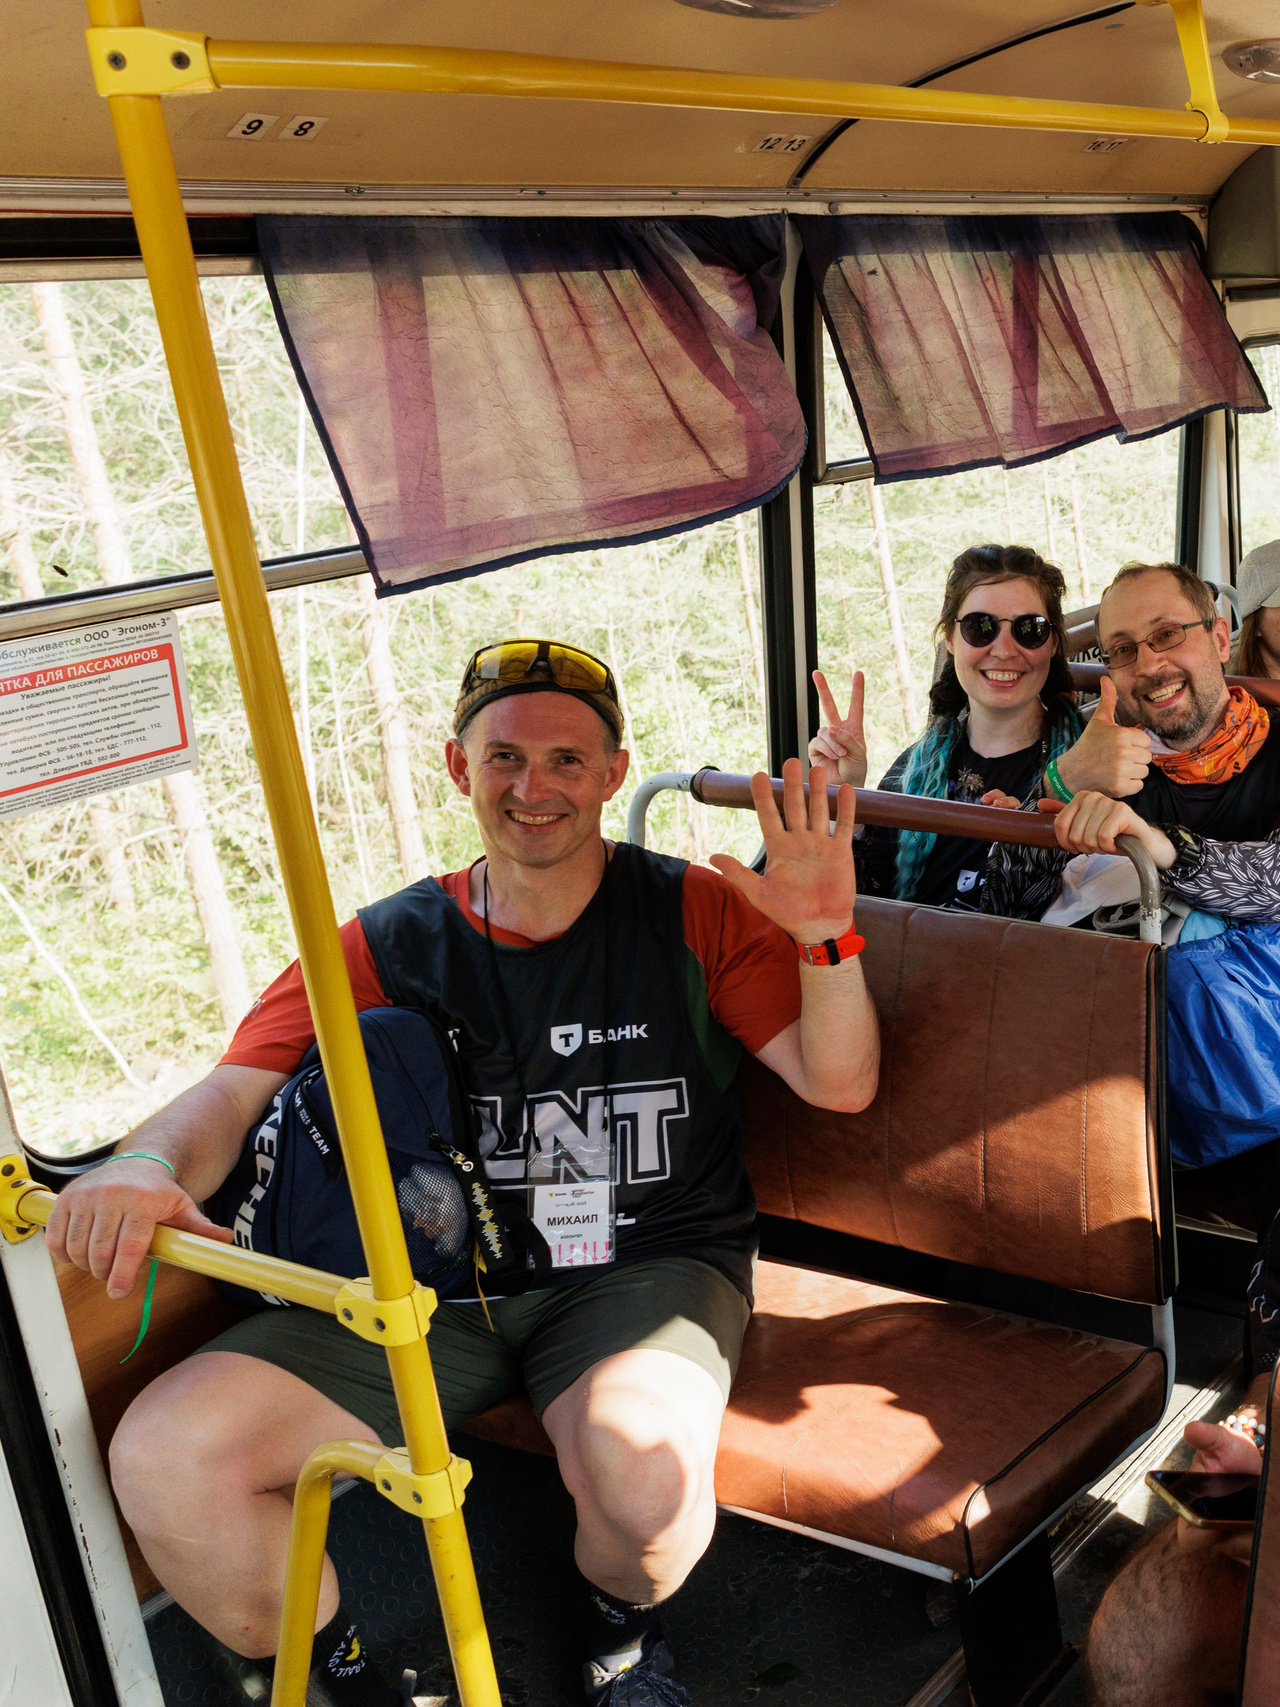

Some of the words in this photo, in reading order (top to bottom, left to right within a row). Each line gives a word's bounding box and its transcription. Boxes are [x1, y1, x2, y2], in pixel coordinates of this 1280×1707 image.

[242, 119, 264, 136] 9
[293, 121, 315, 137] 8
[759, 137, 783, 150] 12
[784, 138, 807, 151] 13
[1087, 140, 1105, 150] 16
[1105, 141, 1124, 151] 17
[0, 637, 81, 660] бслуживается
[83, 629, 109, 642] ООО
[34, 668, 63, 687] ДЛЯ
[66, 648, 159, 678] ПАССАЖИРОВ
[20, 685, 65, 701] Уважаемые
[67, 674, 111, 690] пассажиры!
[588, 1023, 649, 1045] БАНК
[308, 1125, 330, 1155] TEAM
[547, 1214, 598, 1226] МИХАИЛ
